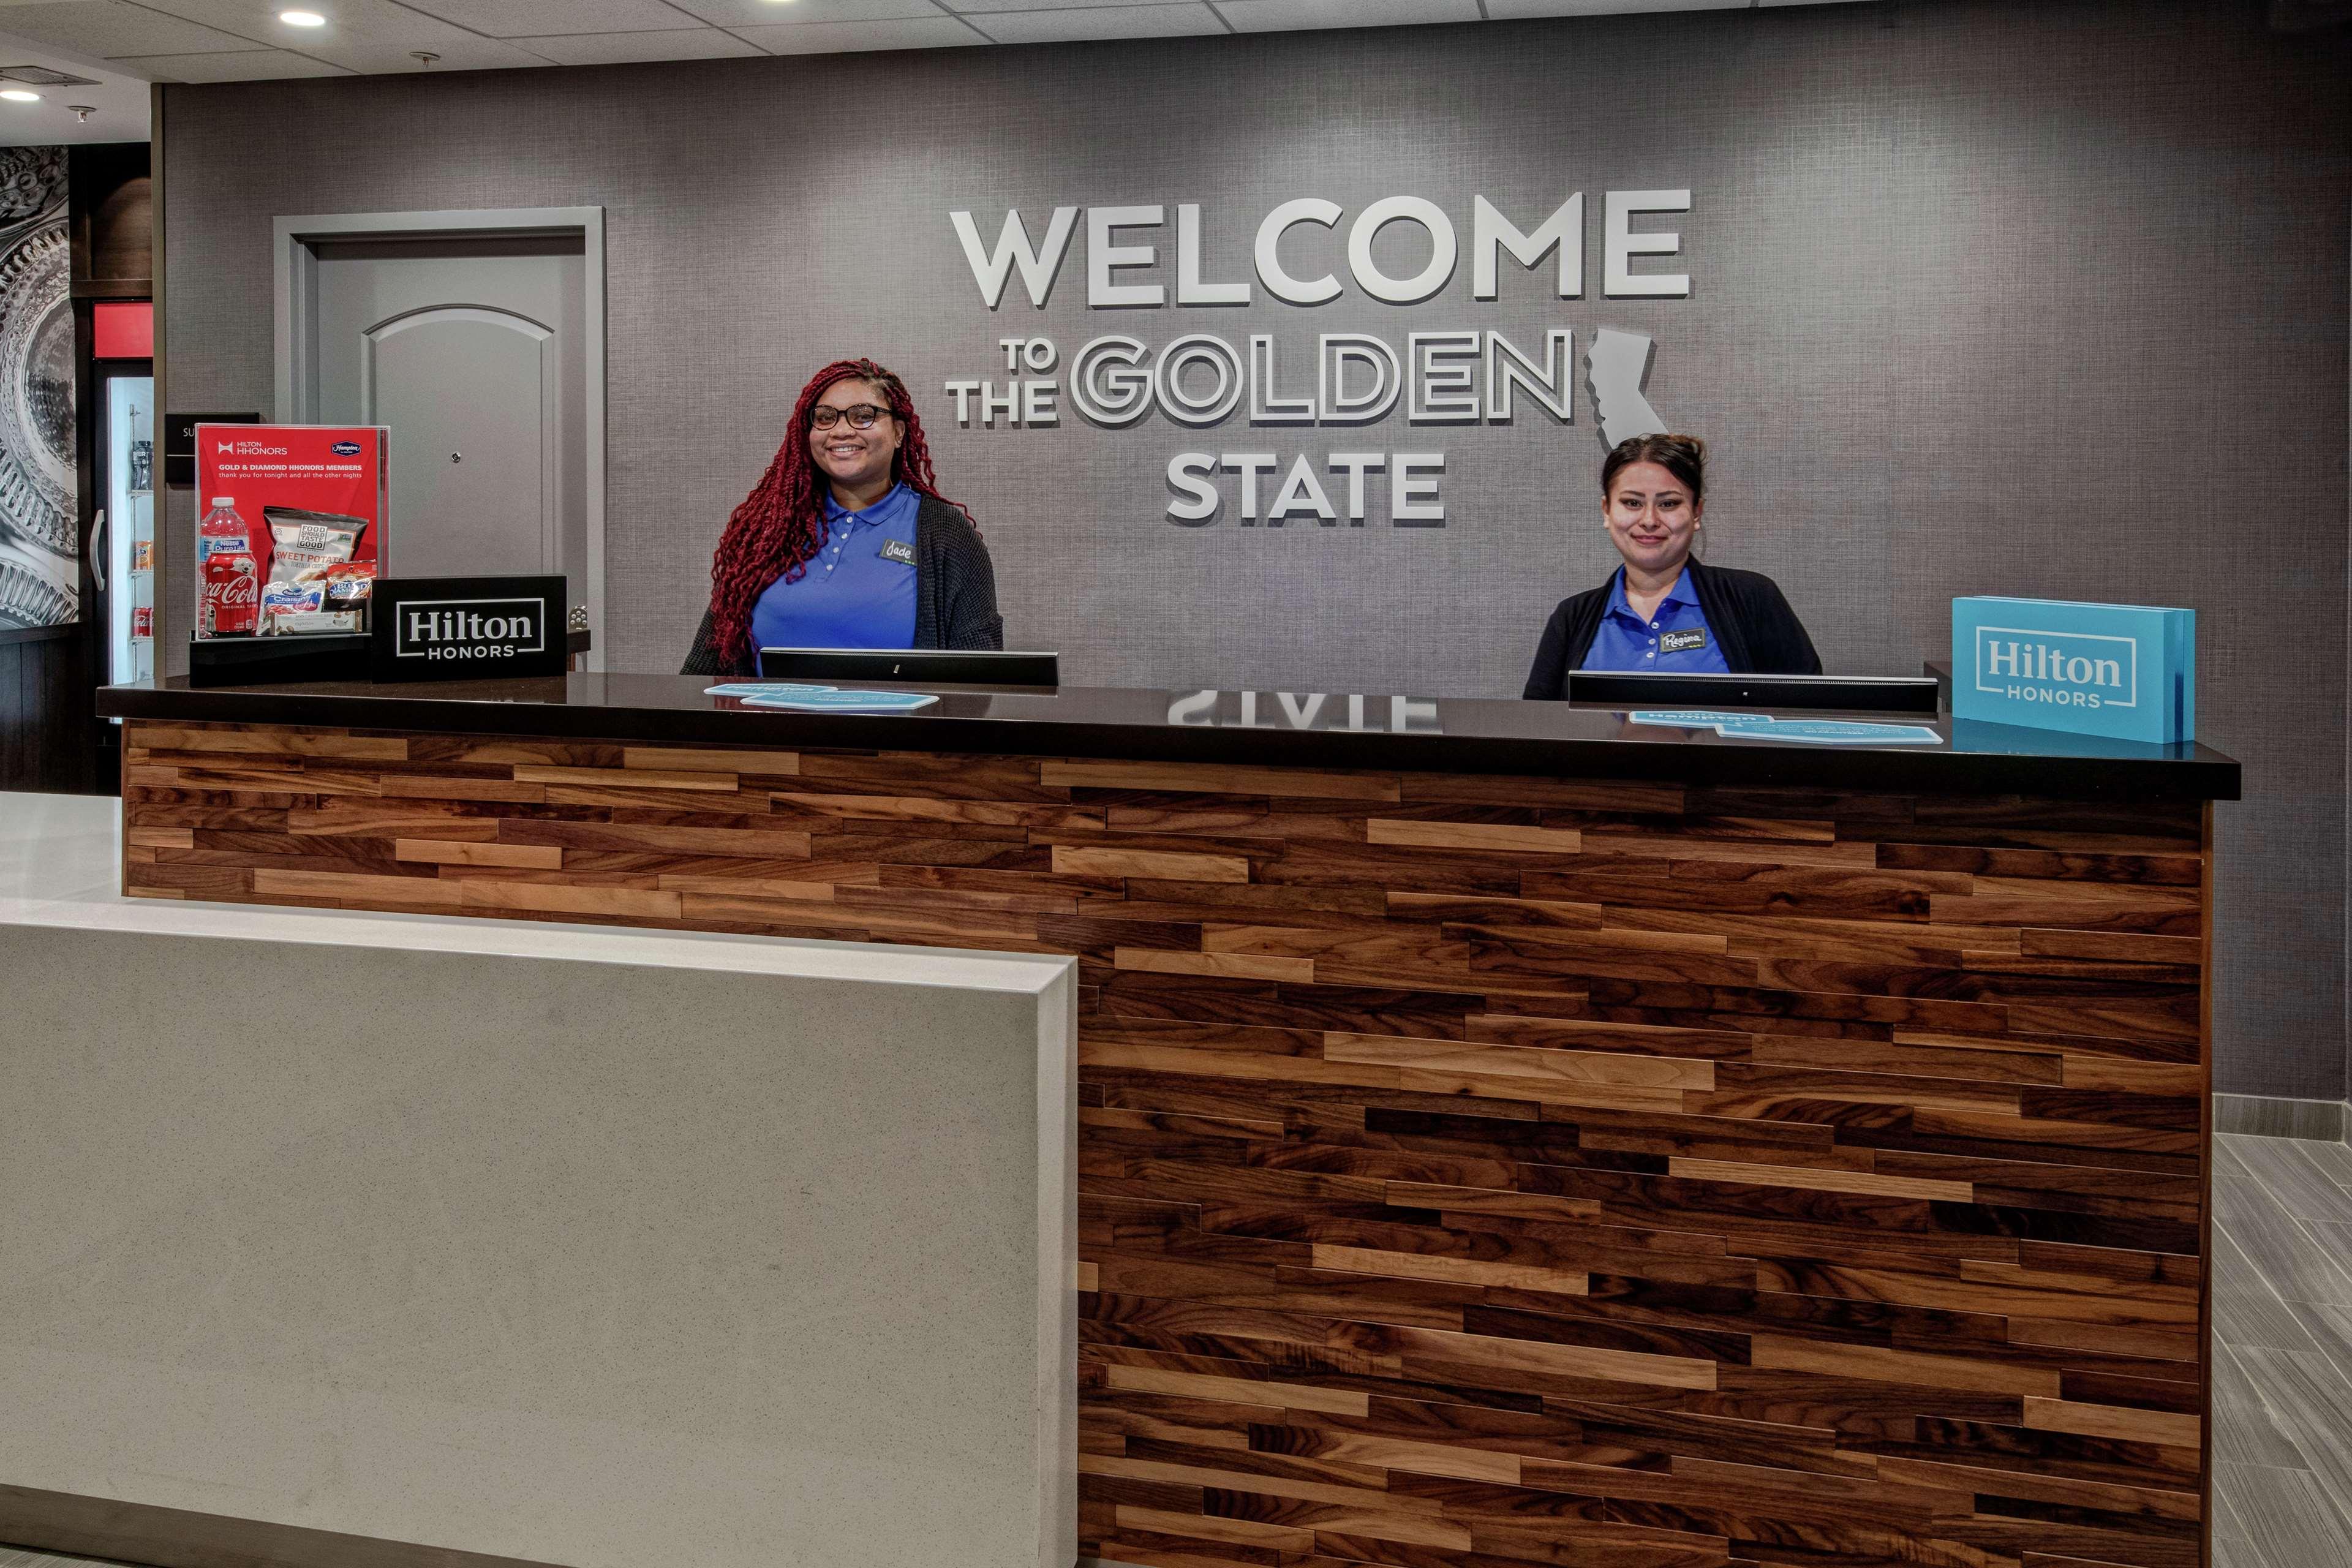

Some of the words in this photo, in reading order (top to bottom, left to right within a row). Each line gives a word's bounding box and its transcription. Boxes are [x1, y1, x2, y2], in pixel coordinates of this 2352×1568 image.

[949, 189, 1692, 308] WELCOME
[999, 337, 1058, 371] TO
[945, 380, 1058, 423] THE
[1070, 329, 1572, 424] GOLDEN
[1167, 452, 1446, 520] STATE
[276, 551, 306, 562] SWEET
[307, 554, 344, 564] POTATO
[886, 540, 911, 559] Jade
[409, 611, 532, 641] Hilton
[1663, 633, 1702, 647] Regina
[428, 645, 514, 660] HONORS
[1988, 640, 2122, 687] Hilton
[2007, 684, 2100, 709] HONORS
